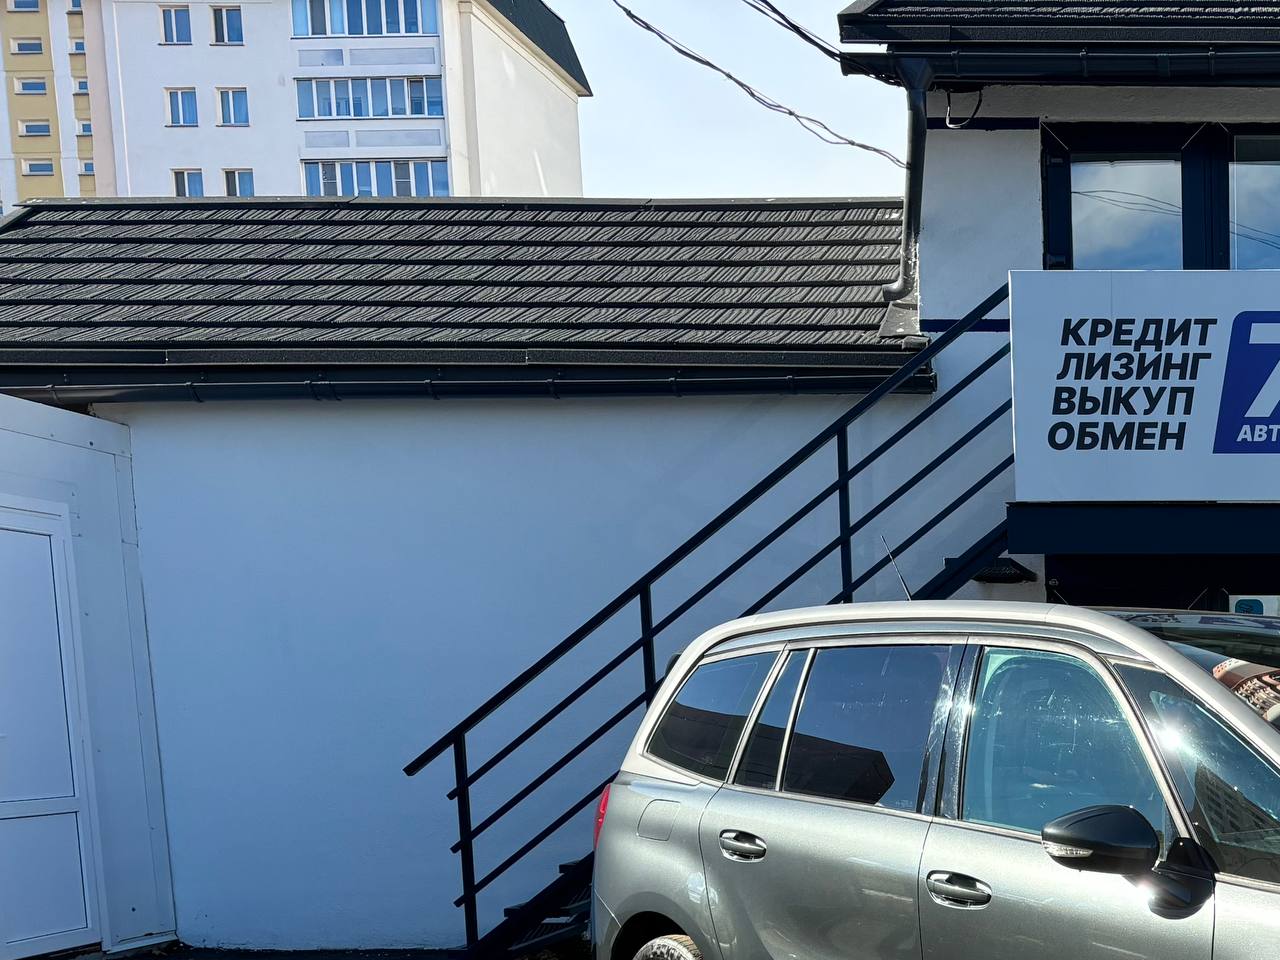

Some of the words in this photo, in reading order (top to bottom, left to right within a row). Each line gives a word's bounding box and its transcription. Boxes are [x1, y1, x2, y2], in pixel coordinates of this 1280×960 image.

[1060, 317, 1218, 352] КРЕДИТ
[1056, 352, 1212, 380] ЛИЗИНГ
[1052, 386, 1195, 416] ВЫКУП
[1047, 421, 1187, 451] ОБМЕН
